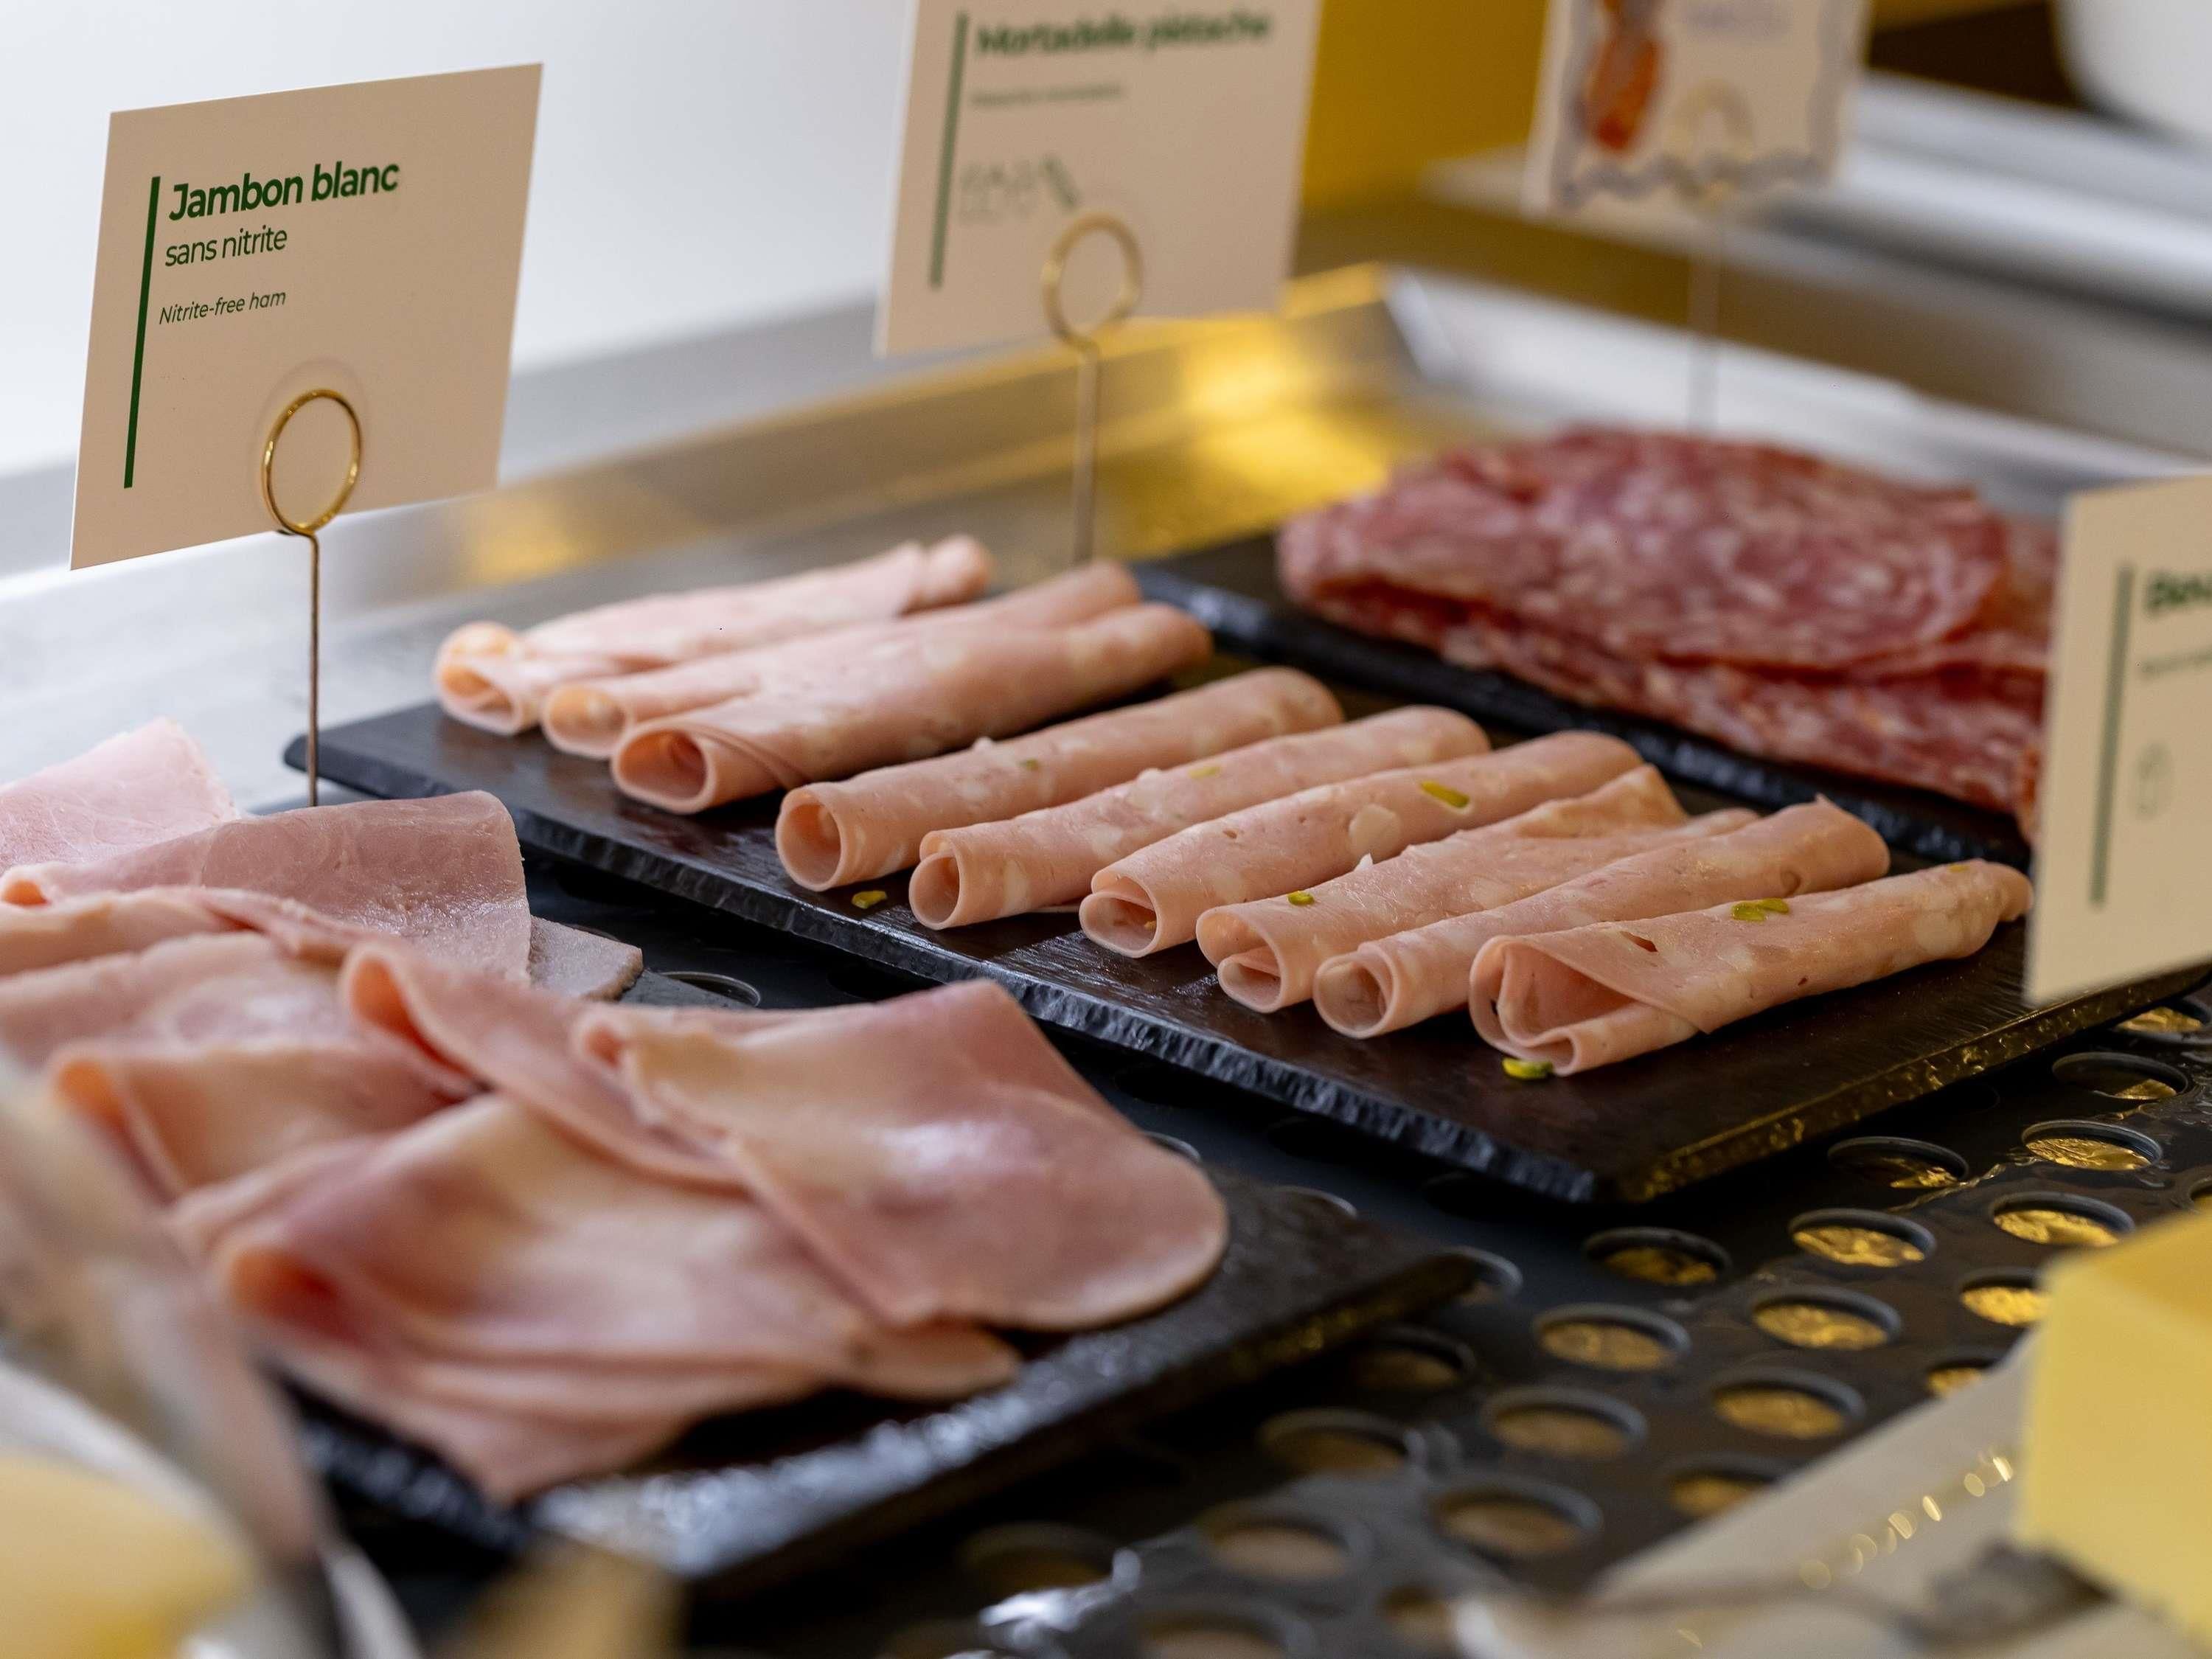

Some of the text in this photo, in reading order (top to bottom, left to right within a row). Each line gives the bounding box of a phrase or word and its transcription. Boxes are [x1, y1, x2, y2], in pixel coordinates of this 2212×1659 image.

[168, 160, 400, 221] Jambon blanc
[164, 224, 288, 267] sans nitrite
[159, 291, 286, 325] Nitrite-free ham
